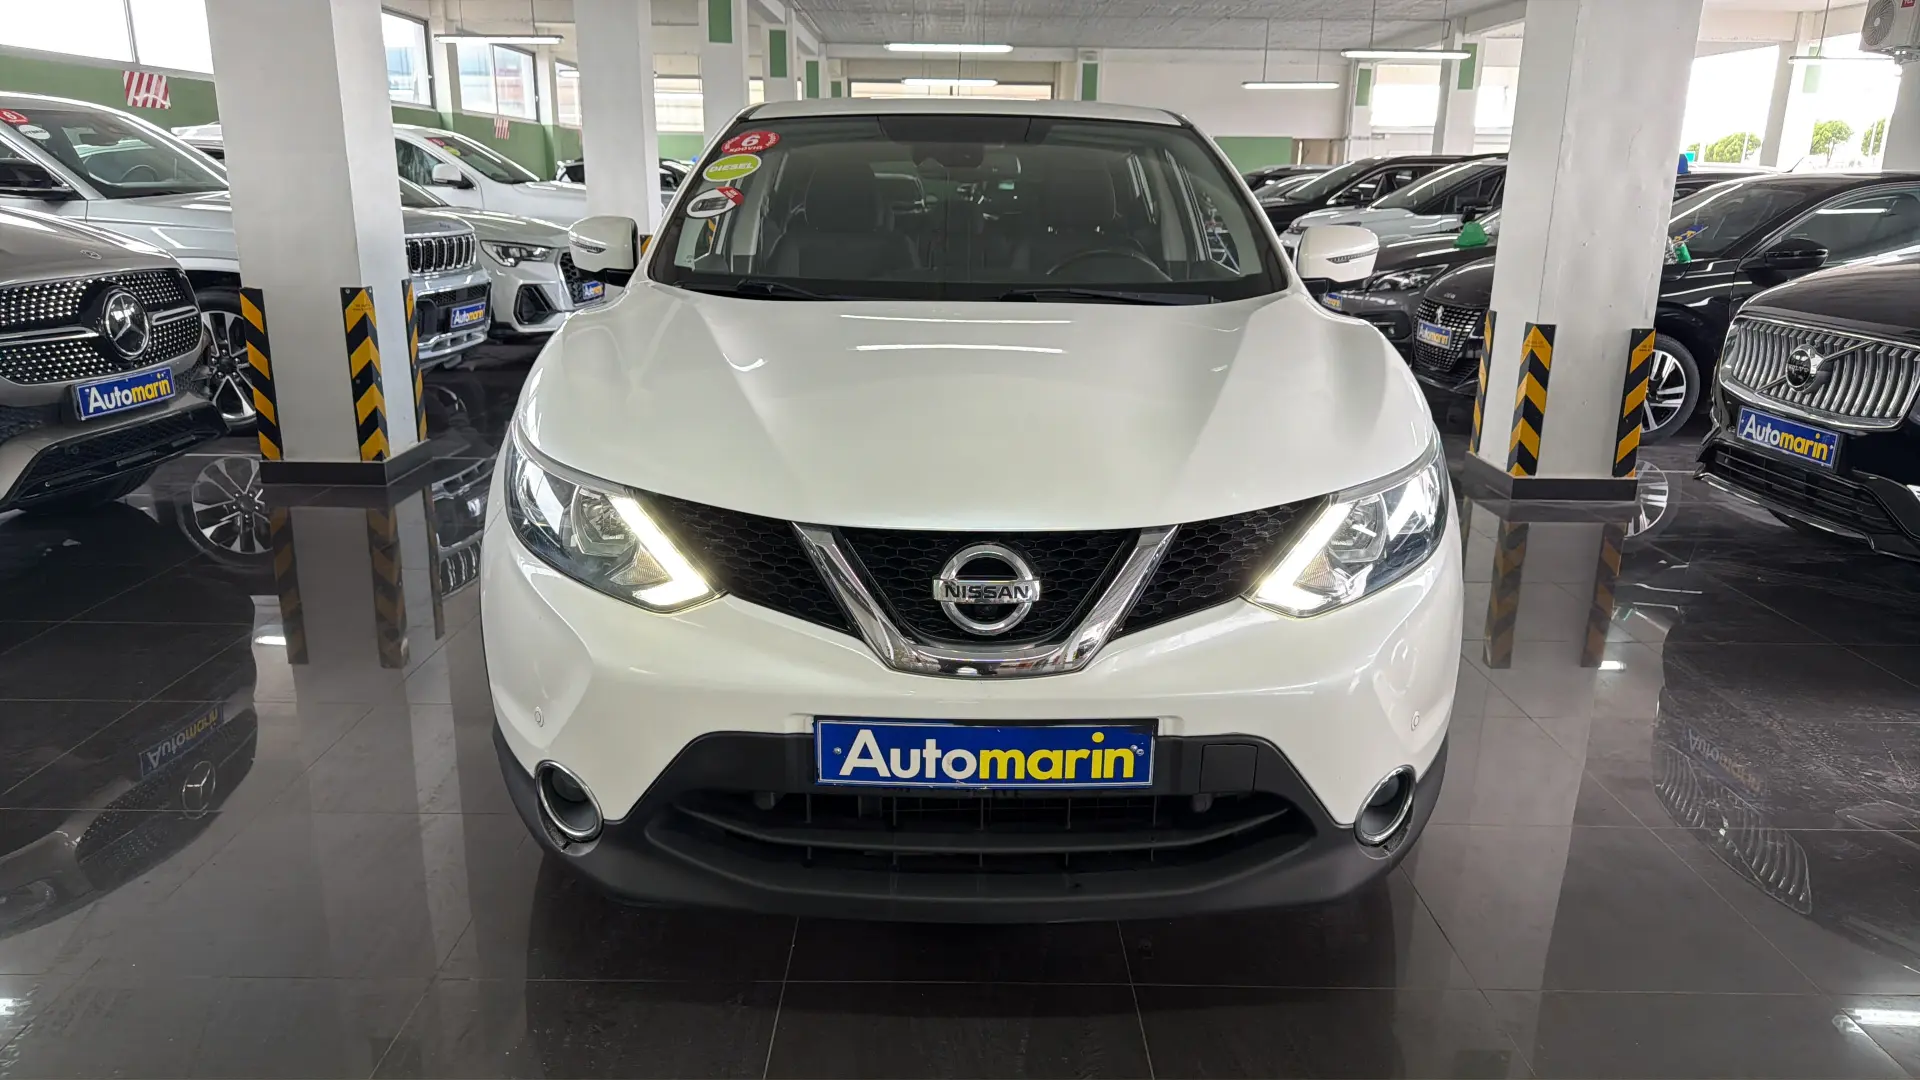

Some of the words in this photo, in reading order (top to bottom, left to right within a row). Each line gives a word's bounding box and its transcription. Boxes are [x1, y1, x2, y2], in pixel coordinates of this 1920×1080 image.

[741, 134, 761, 147] 6
[709, 162, 754, 173] DIESEL
[88, 372, 171, 413] Automarin
[1741, 413, 1829, 461] Automarin
[944, 583, 1030, 600] NISSAN
[838, 729, 1135, 780] Automarin
